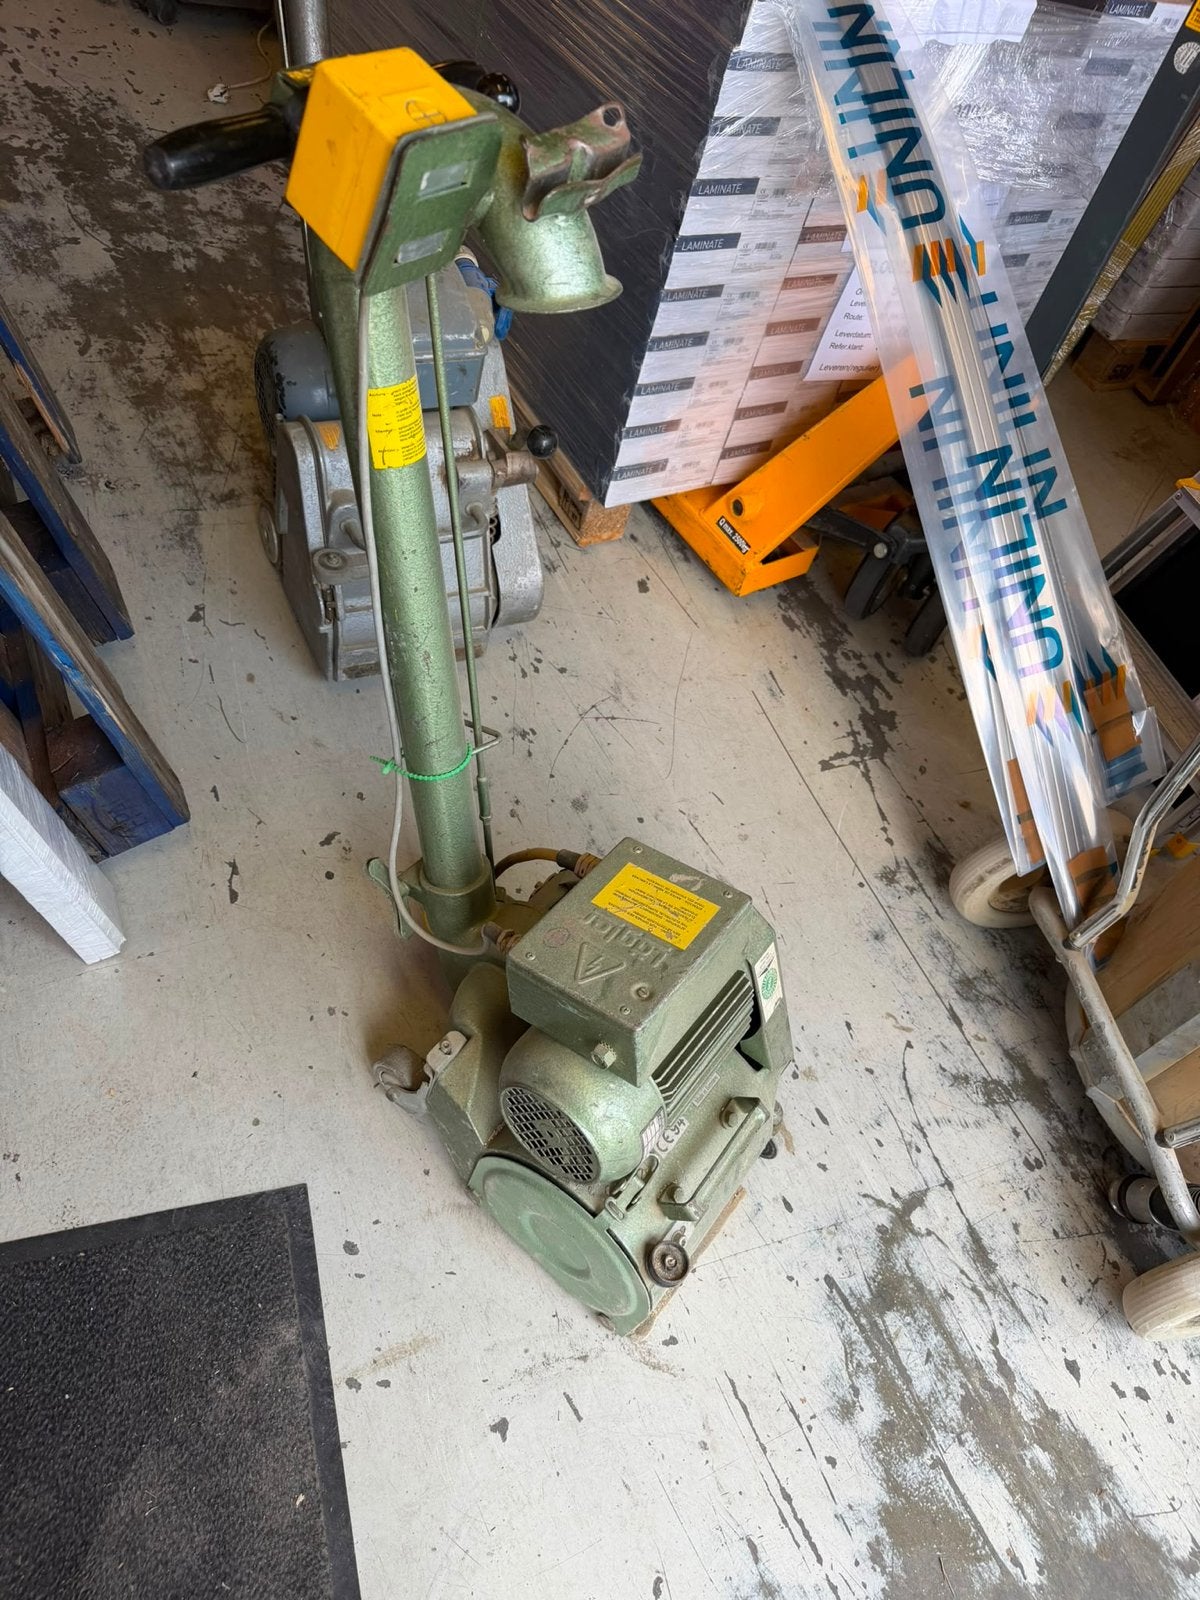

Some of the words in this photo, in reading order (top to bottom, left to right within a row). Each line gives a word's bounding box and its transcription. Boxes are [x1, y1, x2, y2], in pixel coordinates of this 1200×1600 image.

[1109, 3, 1143, 16] LAMINATE
[827, 4, 946, 230] UNILIN
[698, 183, 742, 195] LAMINATE
[681, 238, 724, 251] LAMINATE
[667, 288, 709, 301] LAMINATE
[653, 337, 695, 351] LAMINATE
[640, 383, 680, 396] LAMINATE
[629, 424, 667, 438] LAMINATE
[617, 467, 655, 481] LAMINATE
[718, 517, 726, 526] Q
[966, 444, 1064, 678] UNILIN
